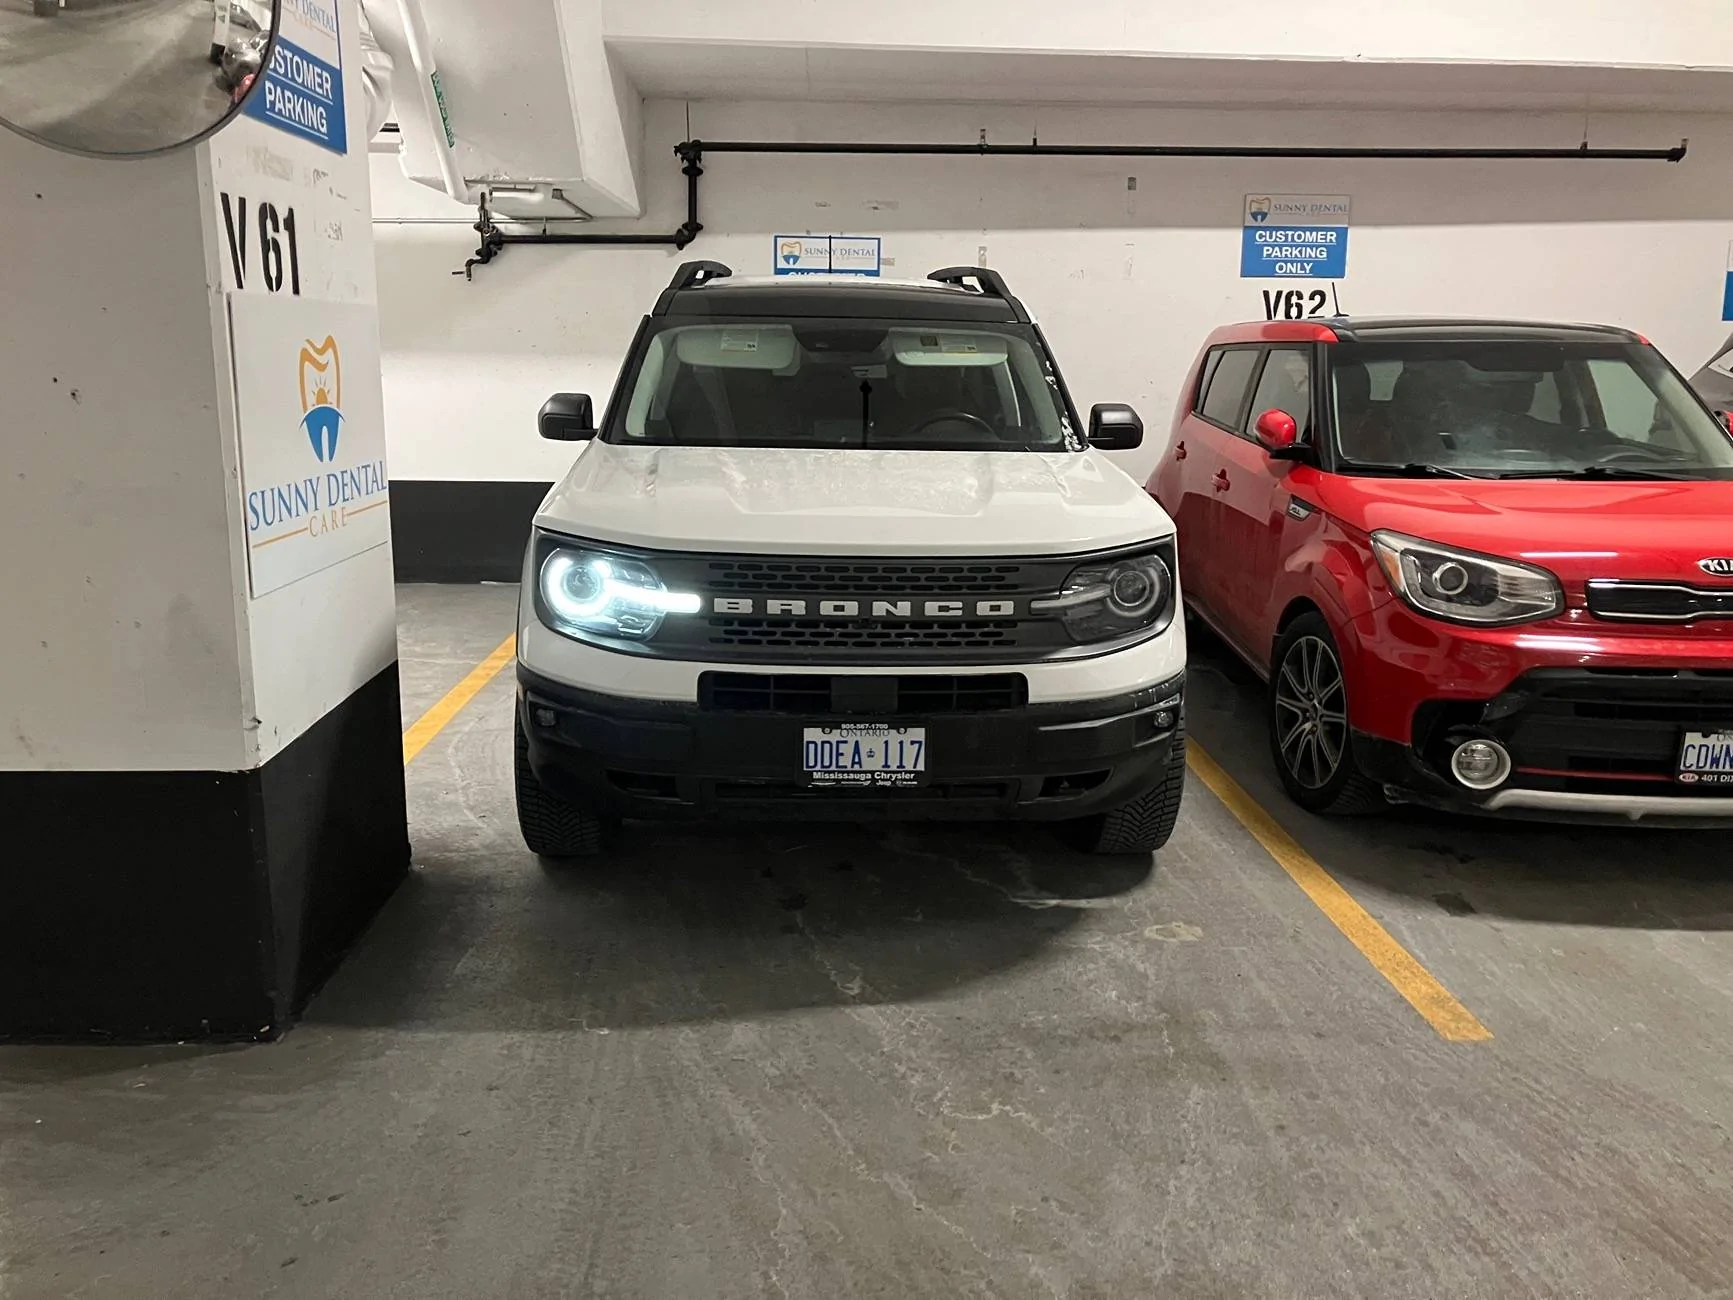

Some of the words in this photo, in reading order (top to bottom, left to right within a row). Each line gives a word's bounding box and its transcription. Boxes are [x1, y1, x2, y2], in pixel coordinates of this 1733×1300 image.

[269, 45, 332, 99] STOMER
[265, 80, 328, 134] PARKING
[1273, 203, 1307, 213] SUNNY
[1310, 203, 1349, 213] DENTAL
[1255, 231, 1337, 243] CUSTOMER
[804, 247, 837, 257] SUNNY
[840, 248, 876, 257] DENTAL
[1263, 246, 1328, 259] PARKING
[1275, 262, 1314, 274] ONLY
[1262, 289, 1327, 320] V62
[248, 476, 320, 531] SUNNY
[326, 460, 387, 507] DENTAL
[309, 506, 347, 538] CARE
[714, 598, 1014, 616] BRONCO
[840, 729, 890, 738] ONTARIO
[805, 740, 863, 769] DDEA
[881, 740, 923, 769] 117
[812, 771, 872, 781] Mississauga
[874, 771, 915, 781] Chrysler
[1701, 774, 1718, 782] 401
